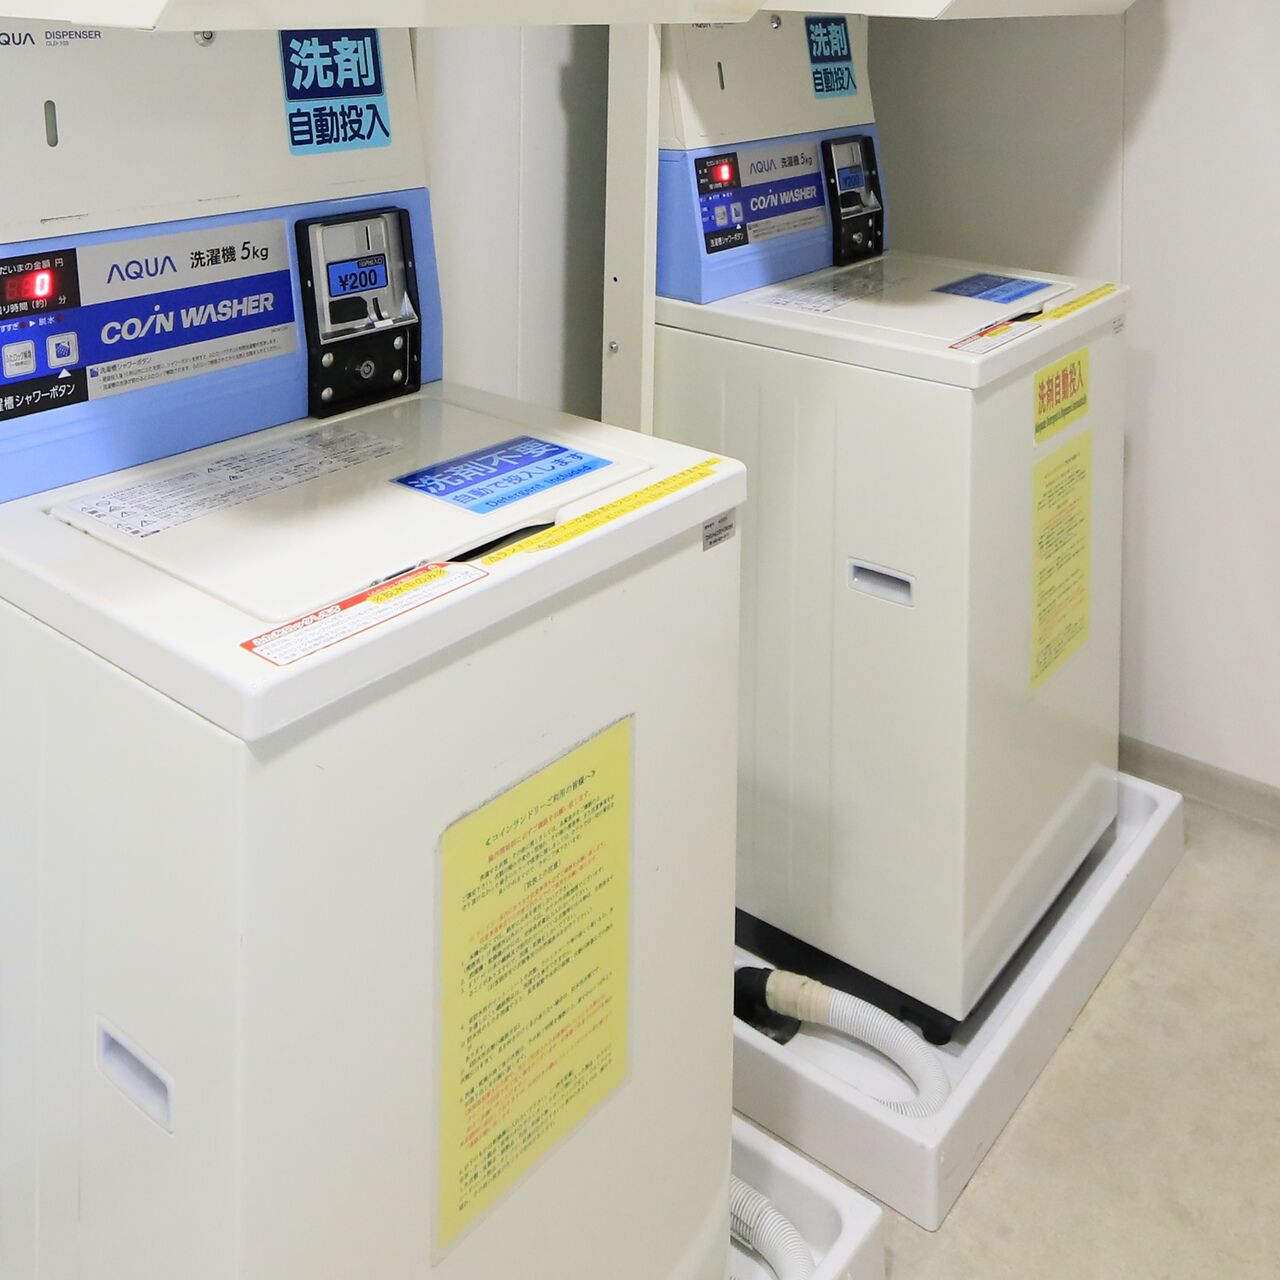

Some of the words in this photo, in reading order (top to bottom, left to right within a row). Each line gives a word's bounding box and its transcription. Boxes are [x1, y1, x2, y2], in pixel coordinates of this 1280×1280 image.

[45, 30, 102, 41] DISPENSER
[809, 24, 846, 57] 洗剤
[289, 36, 376, 90] 洗剤
[812, 68, 856, 94] 自動投入
[289, 102, 390, 146] 自動投入
[750, 160, 776, 174] AQUA
[800, 153, 812, 166] 5kg
[780, 186, 816, 204] WASHER
[55, 258, 64, 267] 円
[190, 246, 236, 269] 洗濯機
[240, 241, 269, 262] 5kg
[106, 256, 178, 284] AQUA
[338, 269, 378, 291] ¥200
[58, 295, 66, 304] 分
[181, 292, 274, 329] WASHER
[0, 323, 18, 332] すすぎ
[39, 316, 55, 326] 脱水
[1037, 361, 1085, 415] 洗剤自動投入
[415, 436, 562, 494] 洗剤不要
[453, 450, 585, 505] 自動で投入します
[485, 482, 542, 509] Detergent
[544, 464, 592, 487] Included
